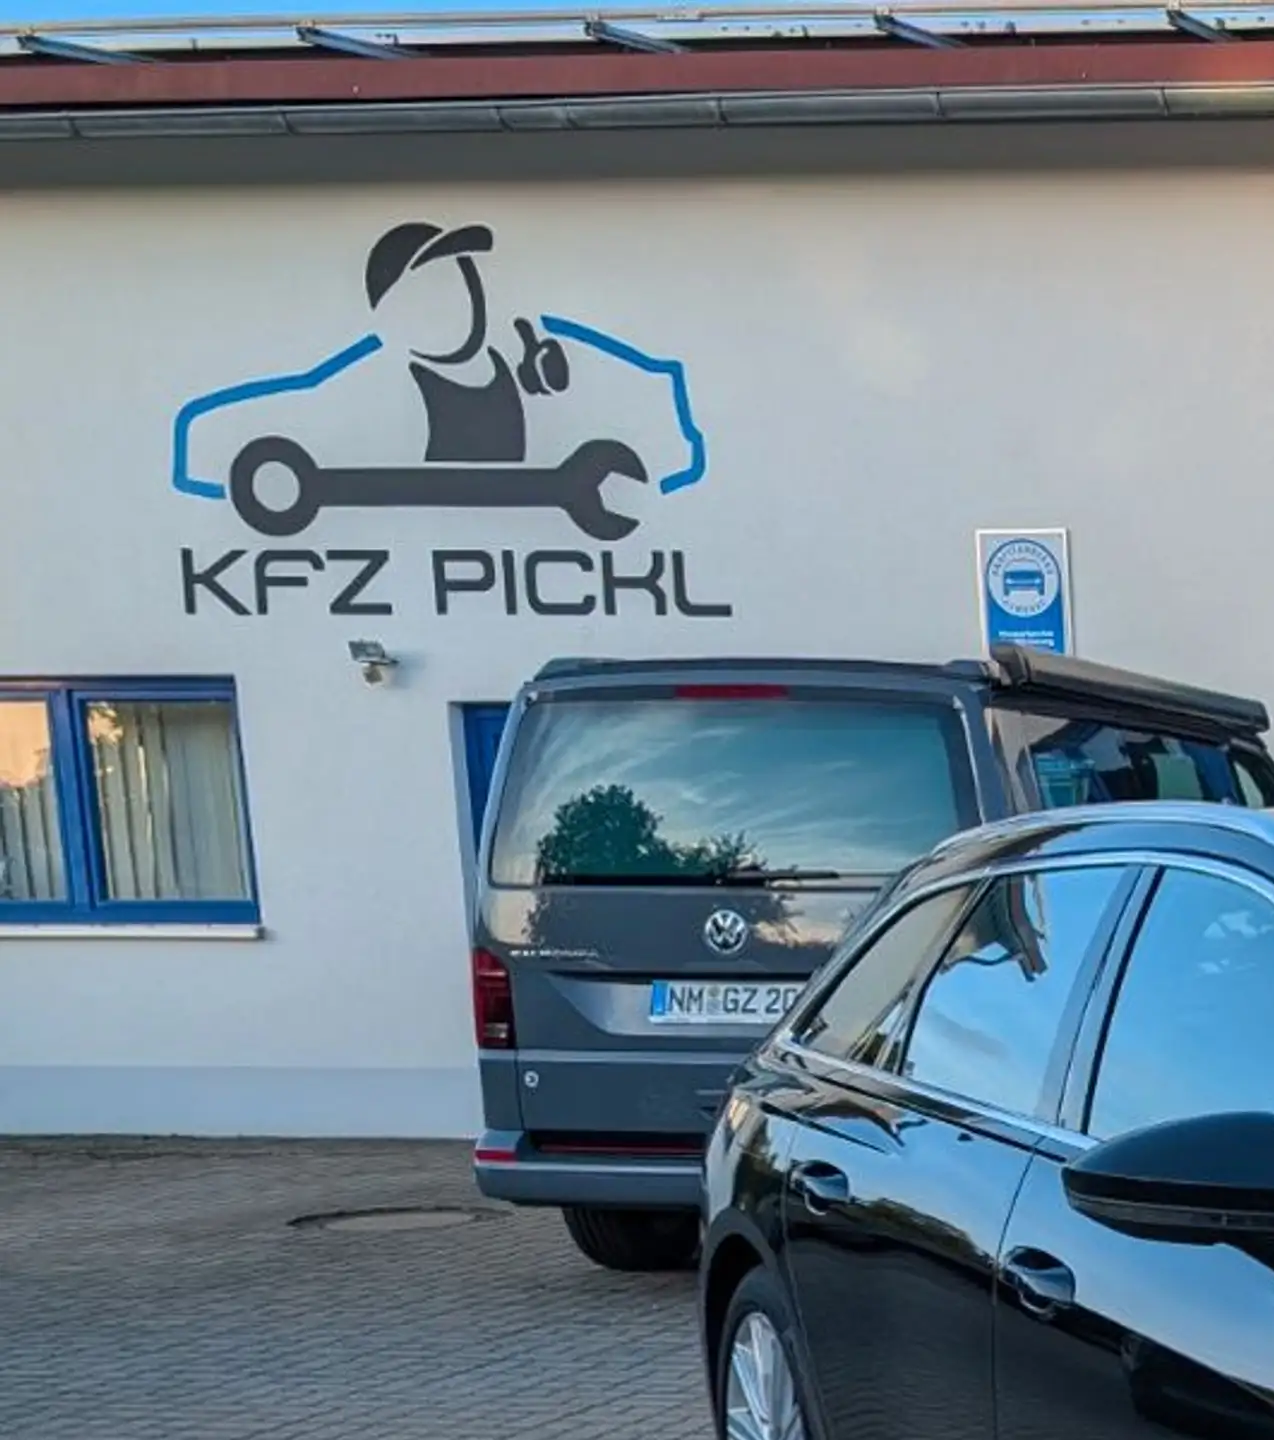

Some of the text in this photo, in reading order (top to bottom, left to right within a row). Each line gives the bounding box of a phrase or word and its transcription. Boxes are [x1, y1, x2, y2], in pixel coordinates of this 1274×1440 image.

[181, 547, 732, 617] KFZ PICKL
[669, 986, 706, 1014] NM
[723, 986, 758, 1014] GZ
